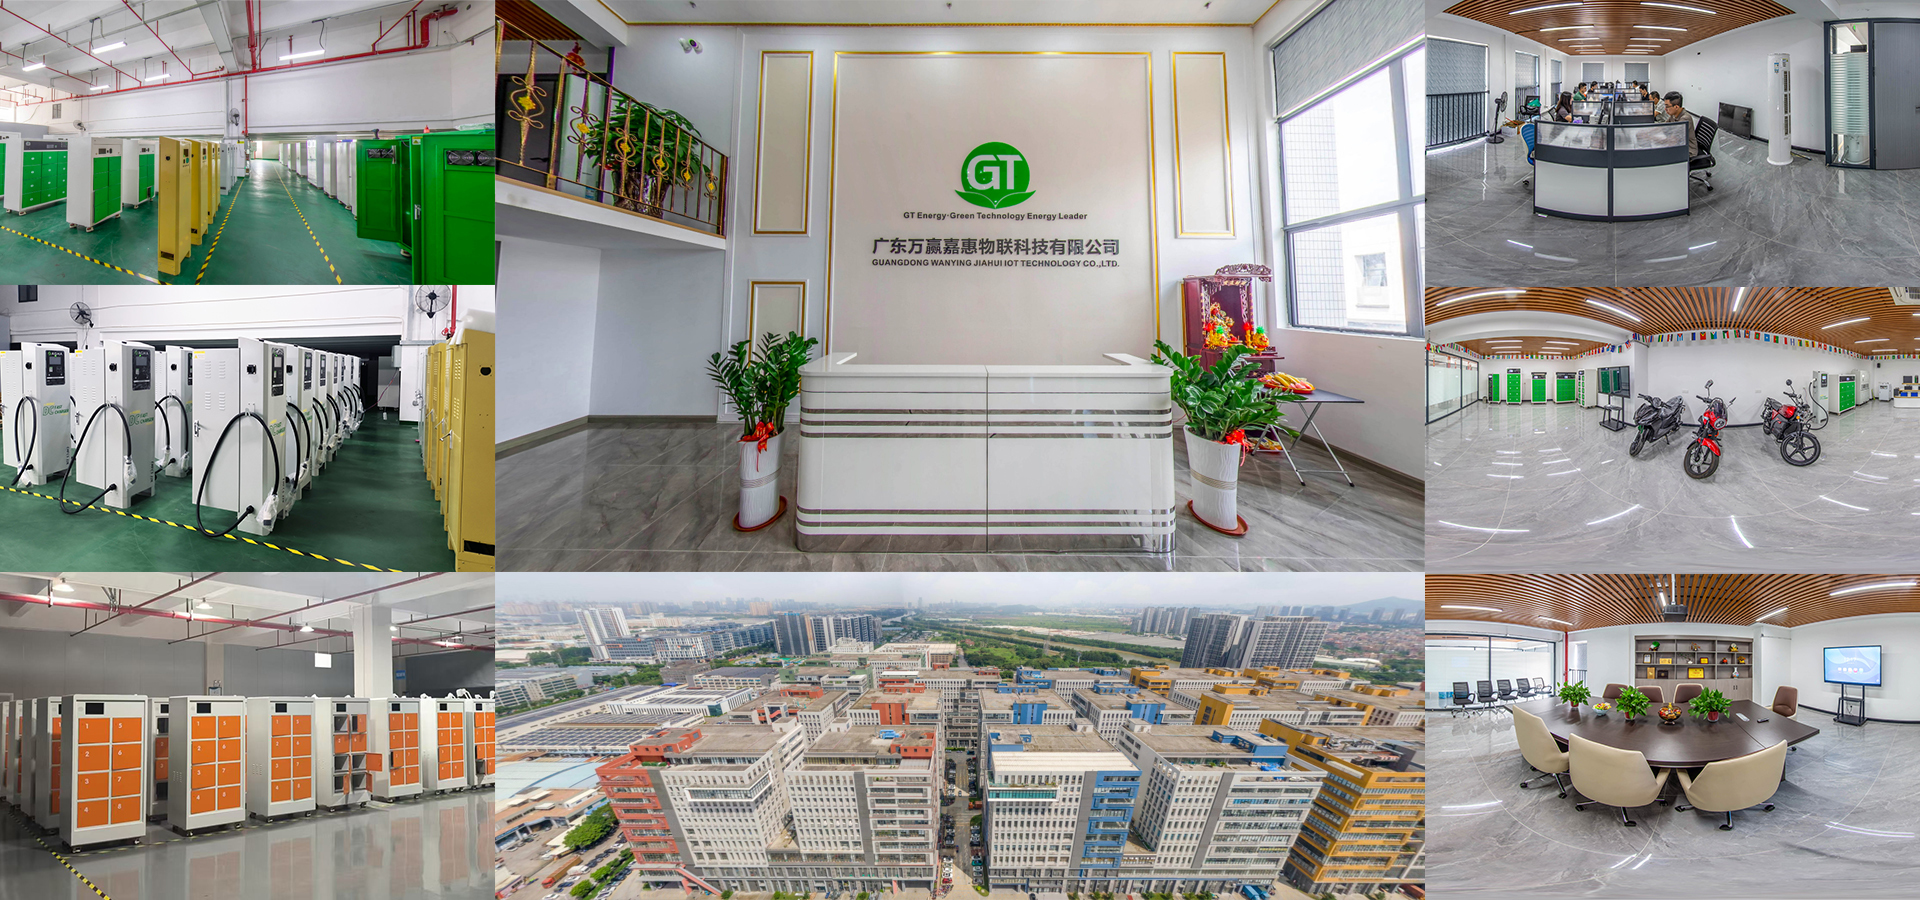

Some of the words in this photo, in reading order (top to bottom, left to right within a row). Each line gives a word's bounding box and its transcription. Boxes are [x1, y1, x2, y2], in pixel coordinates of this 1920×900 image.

[966, 154, 1023, 190] GT
[903, 212, 916, 220] GT
[976, 212, 1026, 222] Technology
[1026, 212, 1057, 222] Energy
[1058, 212, 1088, 220] Leader
[872, 237, 1120, 256] 广东万赢嘉惠物联科技有限公司
[872, 258, 930, 267] GUANGDONG
[930, 259, 972, 267] WANYING
[974, 259, 1003, 267] JIAHUI
[1004, 259, 1019, 267] IOT
[1020, 259, 1081, 267] TECHNOLOGY
[1082, 259, 1120, 268] CO.,LTD.
